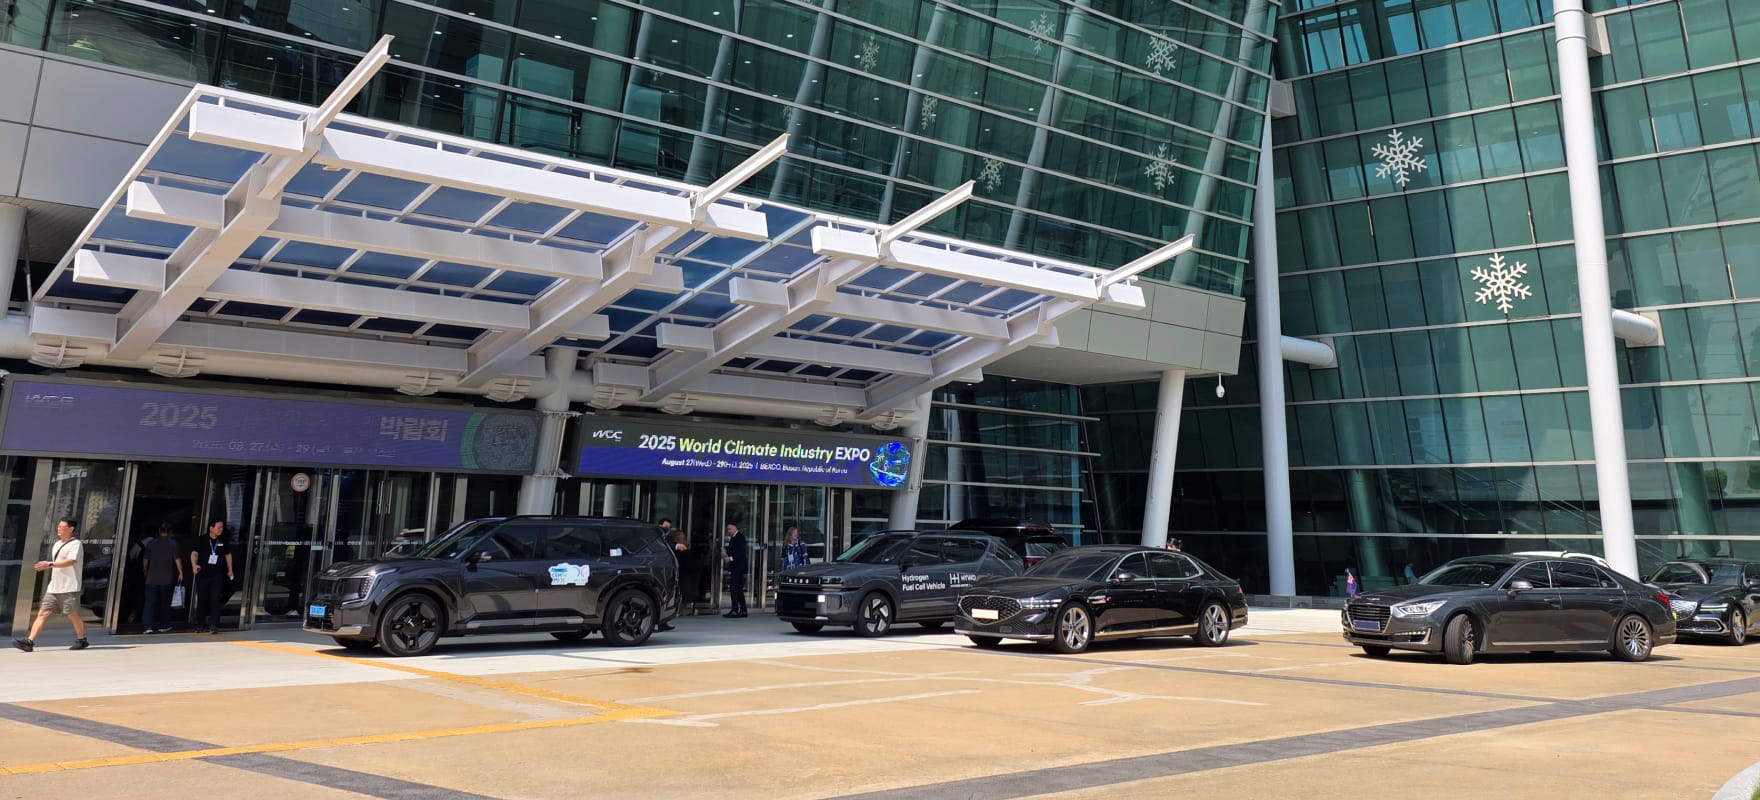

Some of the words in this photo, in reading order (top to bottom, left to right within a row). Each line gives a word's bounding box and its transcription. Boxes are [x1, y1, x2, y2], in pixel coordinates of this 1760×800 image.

[139, 402, 219, 429] 2025
[380, 415, 448, 441] 박람회
[639, 435, 676, 450] 2025
[679, 438, 721, 454] World
[724, 440, 777, 457] Climate
[780, 444, 833, 463] Industry
[835, 447, 870, 462] EXPO
[662, 458, 685, 467] August
[902, 575, 929, 583] Hydrogen
[915, 583, 925, 591] Cell
[927, 582, 946, 590] Vehicle
